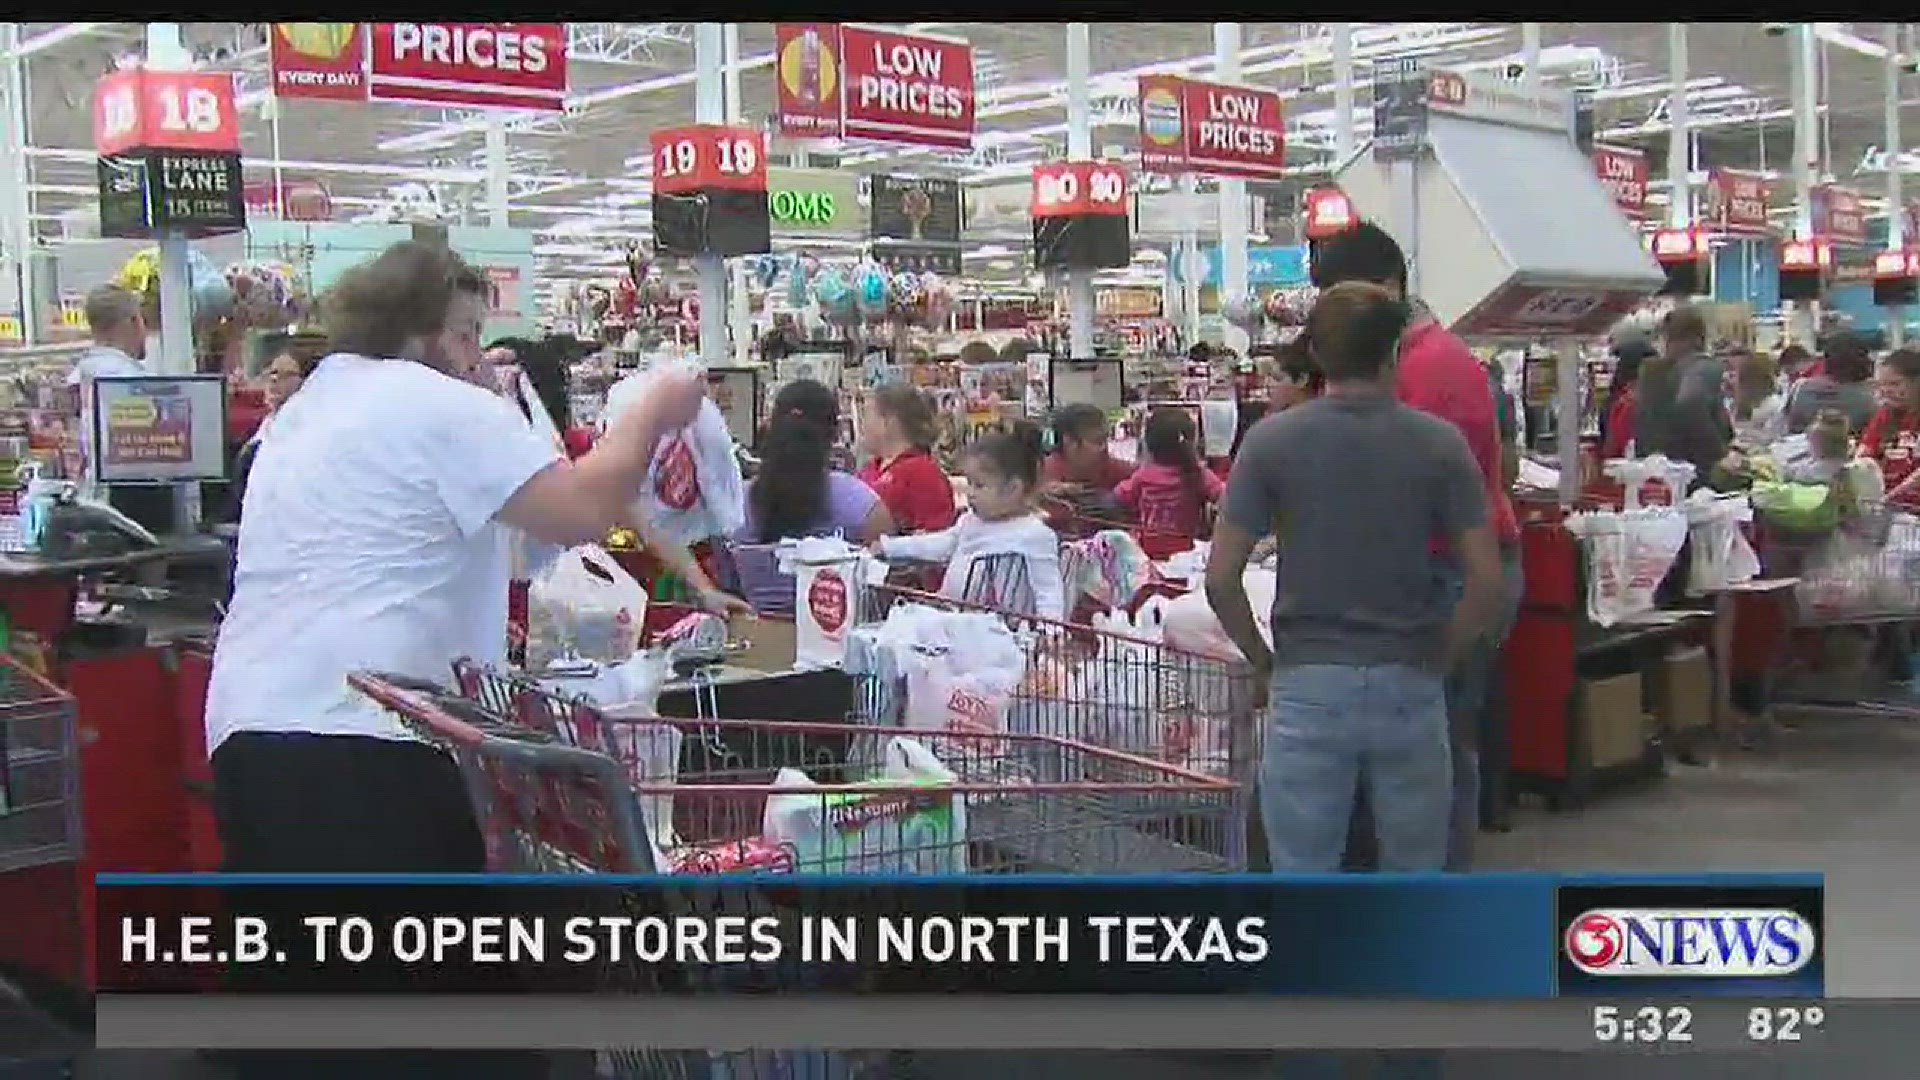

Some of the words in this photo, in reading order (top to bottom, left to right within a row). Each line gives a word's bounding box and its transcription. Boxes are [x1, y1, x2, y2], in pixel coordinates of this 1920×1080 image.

[394, 23, 547, 71] PRICES
[873, 40, 942, 80] LOW
[160, 85, 221, 131] 18
[860, 74, 963, 119] PRICES
[1208, 91, 1259, 123] LOW
[718, 137, 755, 174] 19
[1200, 121, 1275, 154] PRICES
[661, 140, 696, 176] 19
[163, 169, 230, 191] LANE
